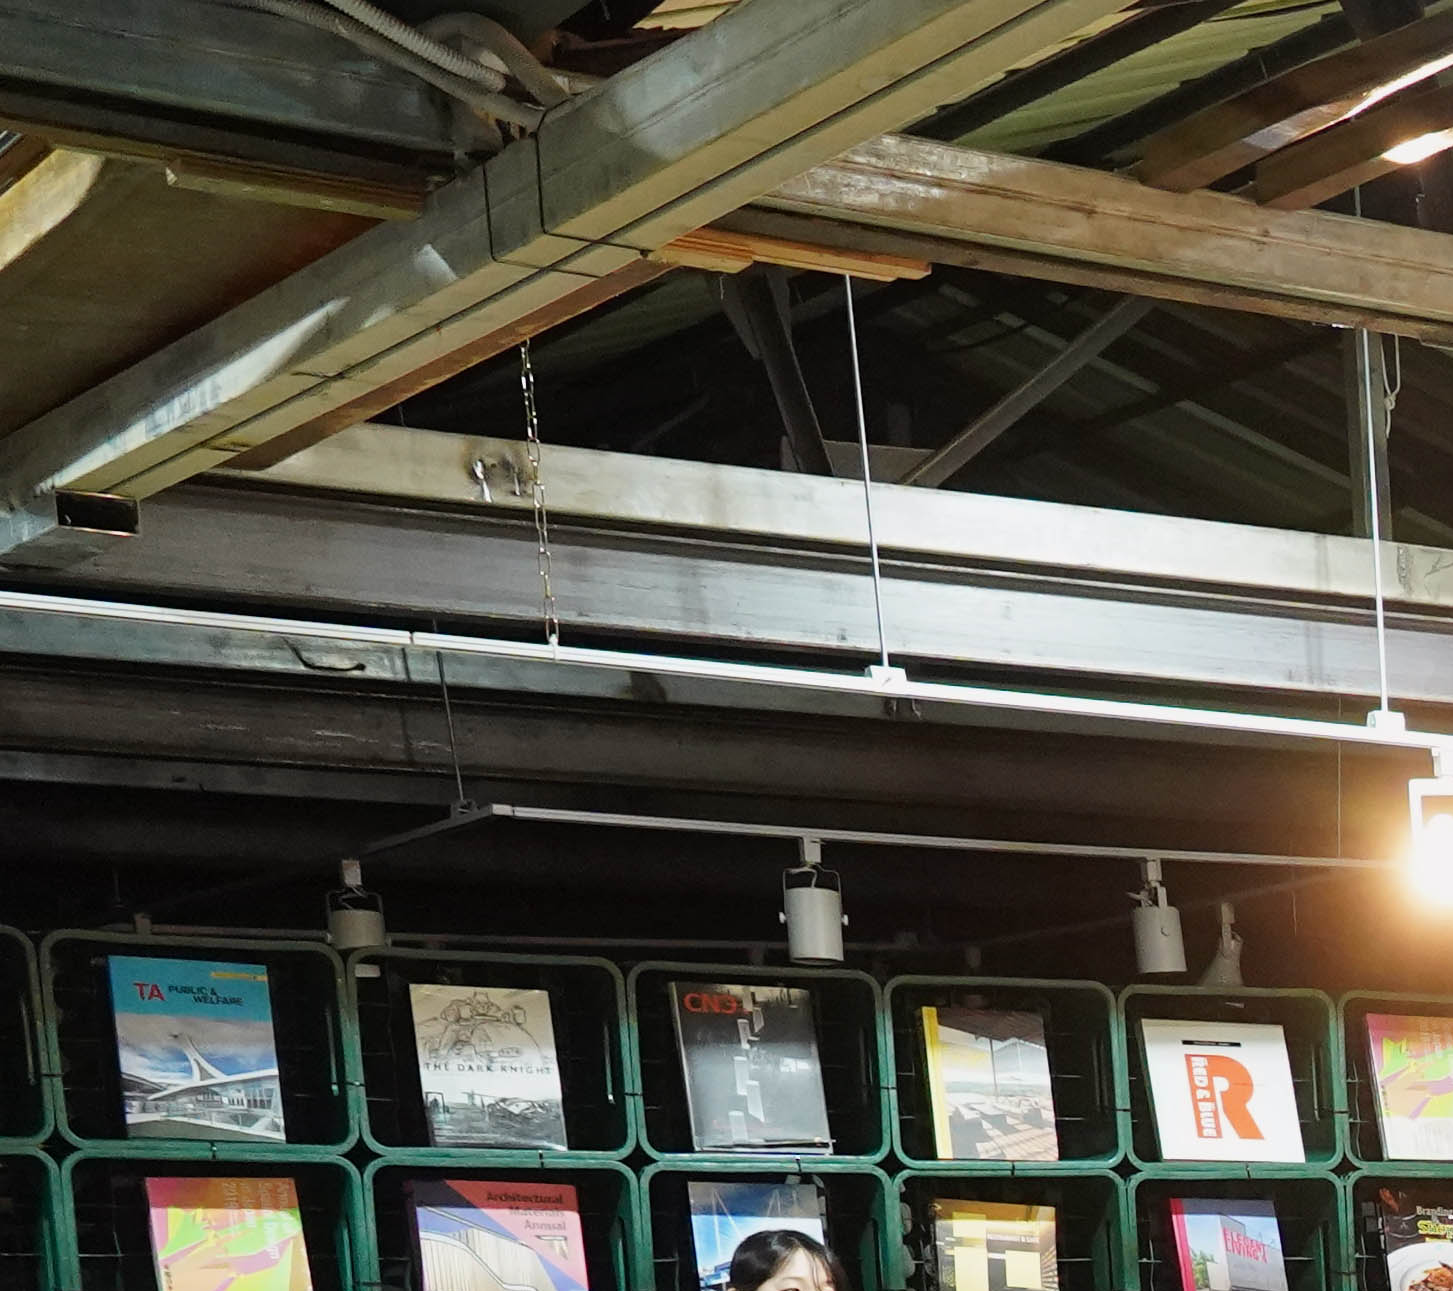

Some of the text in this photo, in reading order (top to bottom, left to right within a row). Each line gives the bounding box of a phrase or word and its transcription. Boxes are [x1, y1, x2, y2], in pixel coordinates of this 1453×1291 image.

[133, 981, 166, 1002] TA
[424, 1062, 553, 1075] THE DARK KNIGHT
